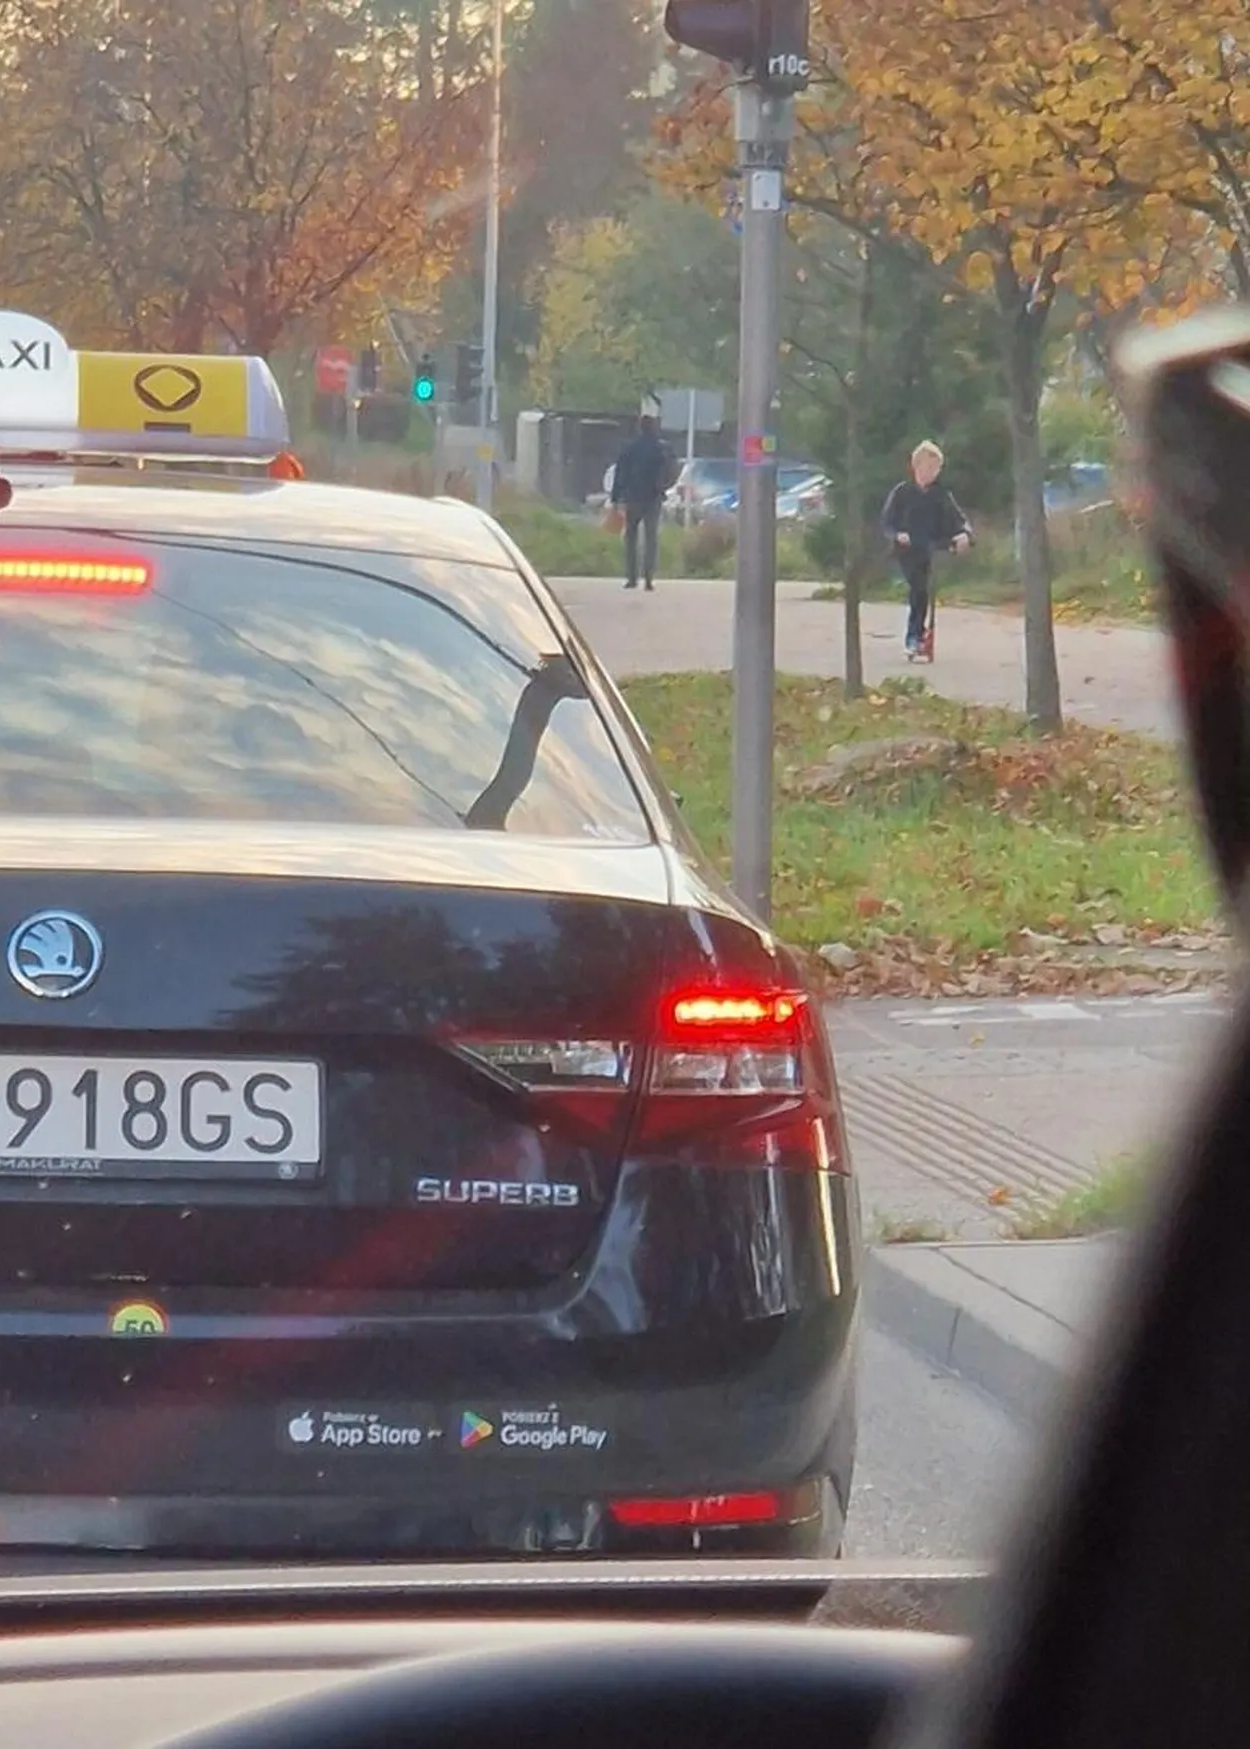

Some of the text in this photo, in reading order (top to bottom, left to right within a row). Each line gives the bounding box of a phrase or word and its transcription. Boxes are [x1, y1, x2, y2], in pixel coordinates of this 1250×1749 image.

[768, 53, 810, 77] r10c
[5, 1068, 294, 1155] 918GS
[416, 1177, 579, 1206] SUPERB
[321, 1423, 422, 1447] App Store
[501, 1425, 607, 1450] Google Play
